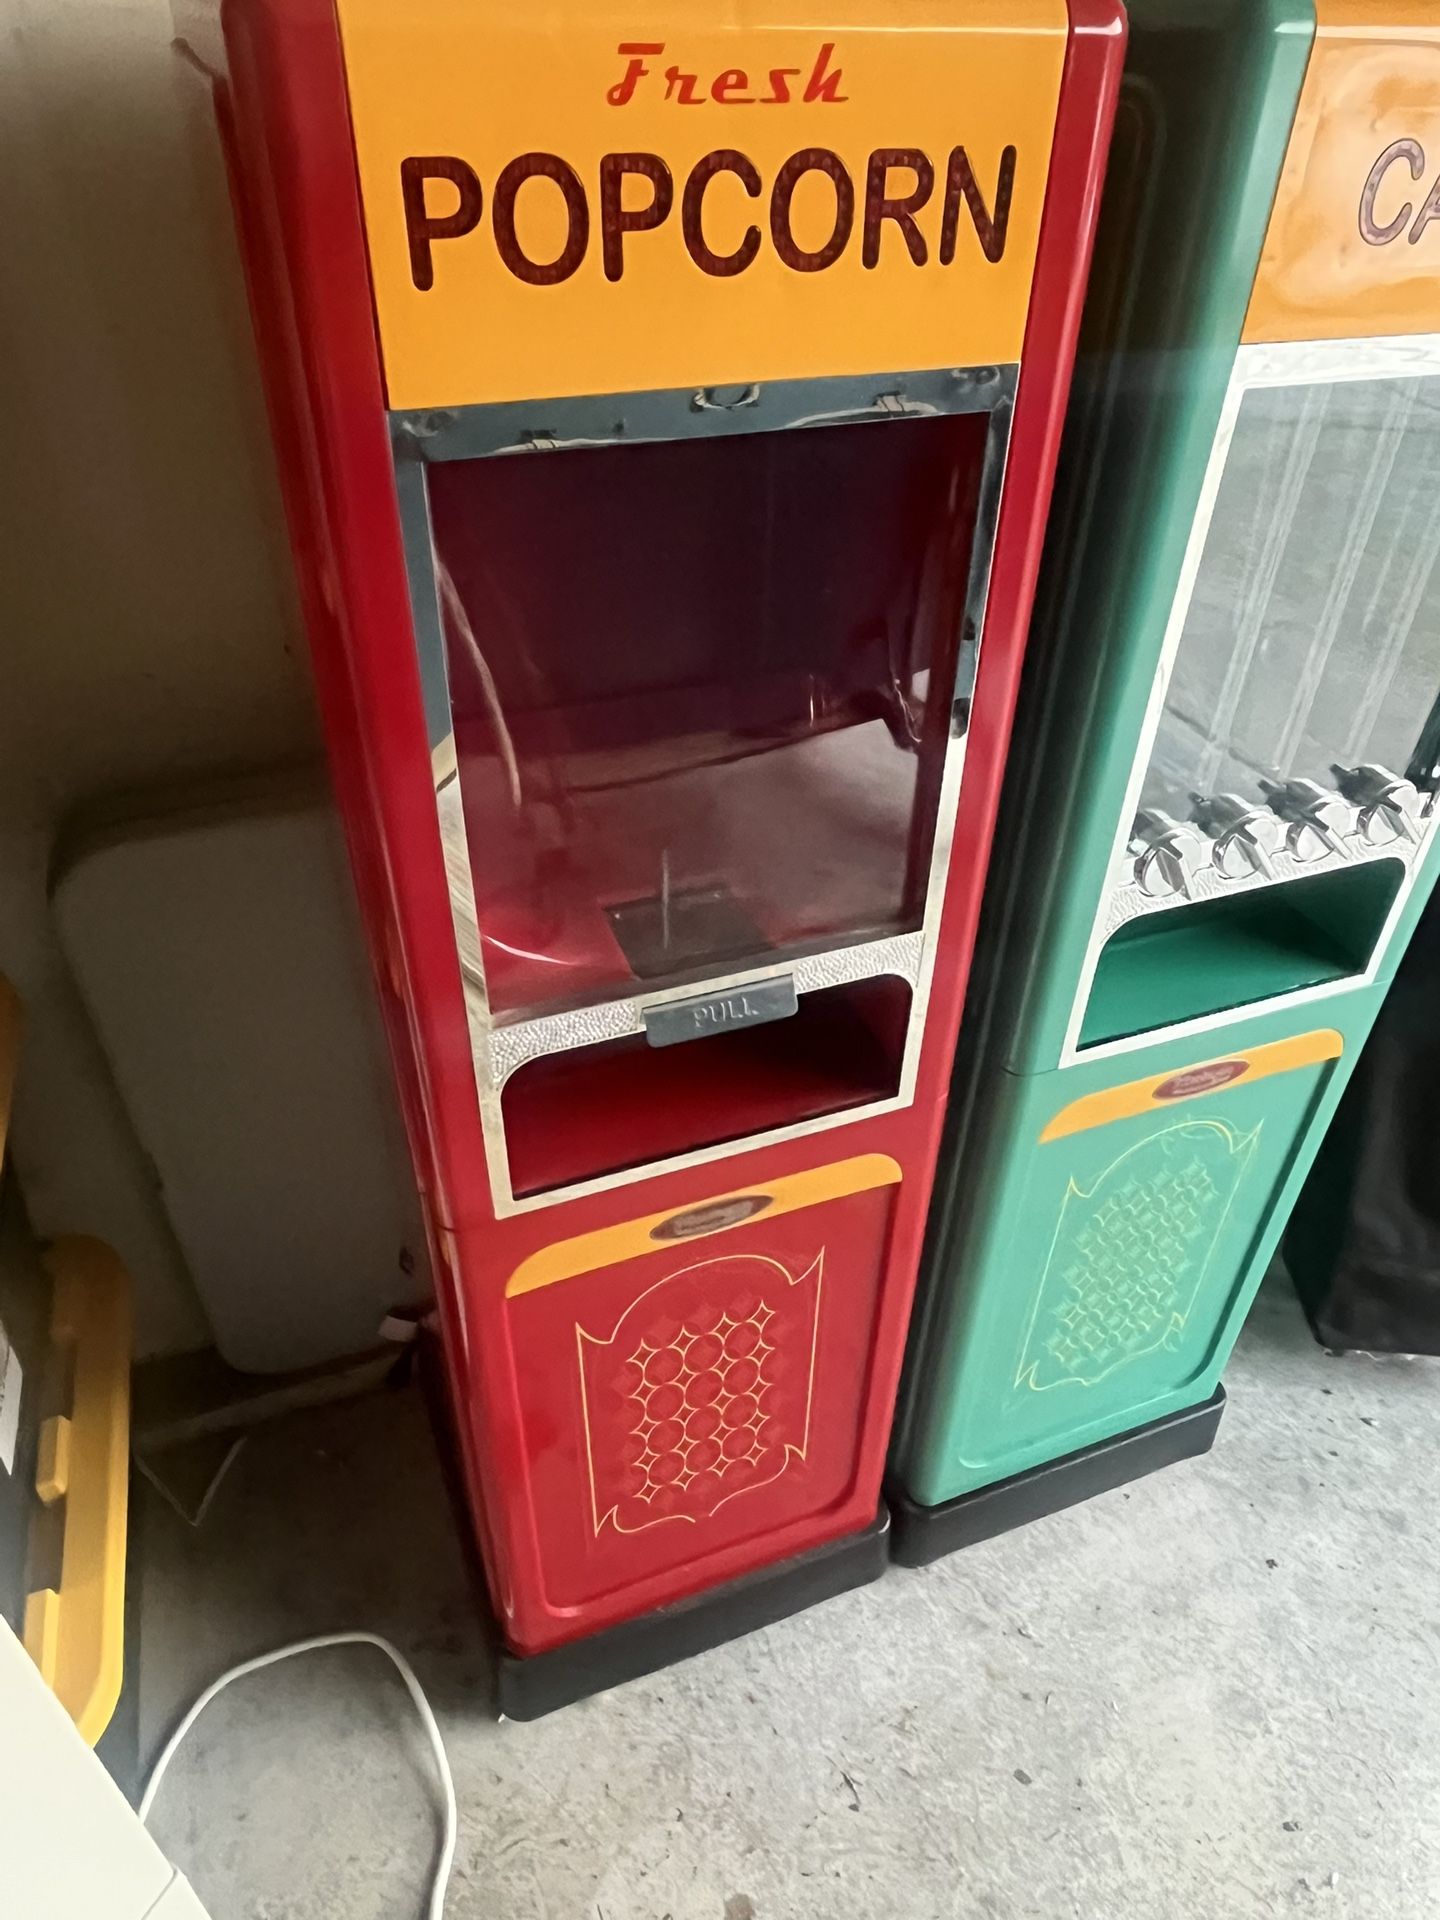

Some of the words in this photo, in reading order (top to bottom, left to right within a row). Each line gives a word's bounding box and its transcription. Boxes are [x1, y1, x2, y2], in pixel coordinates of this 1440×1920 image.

[606, 42, 850, 107] Fresh
[400, 145, 1017, 292] POPCORN
[694, 996, 759, 1028] PULL
